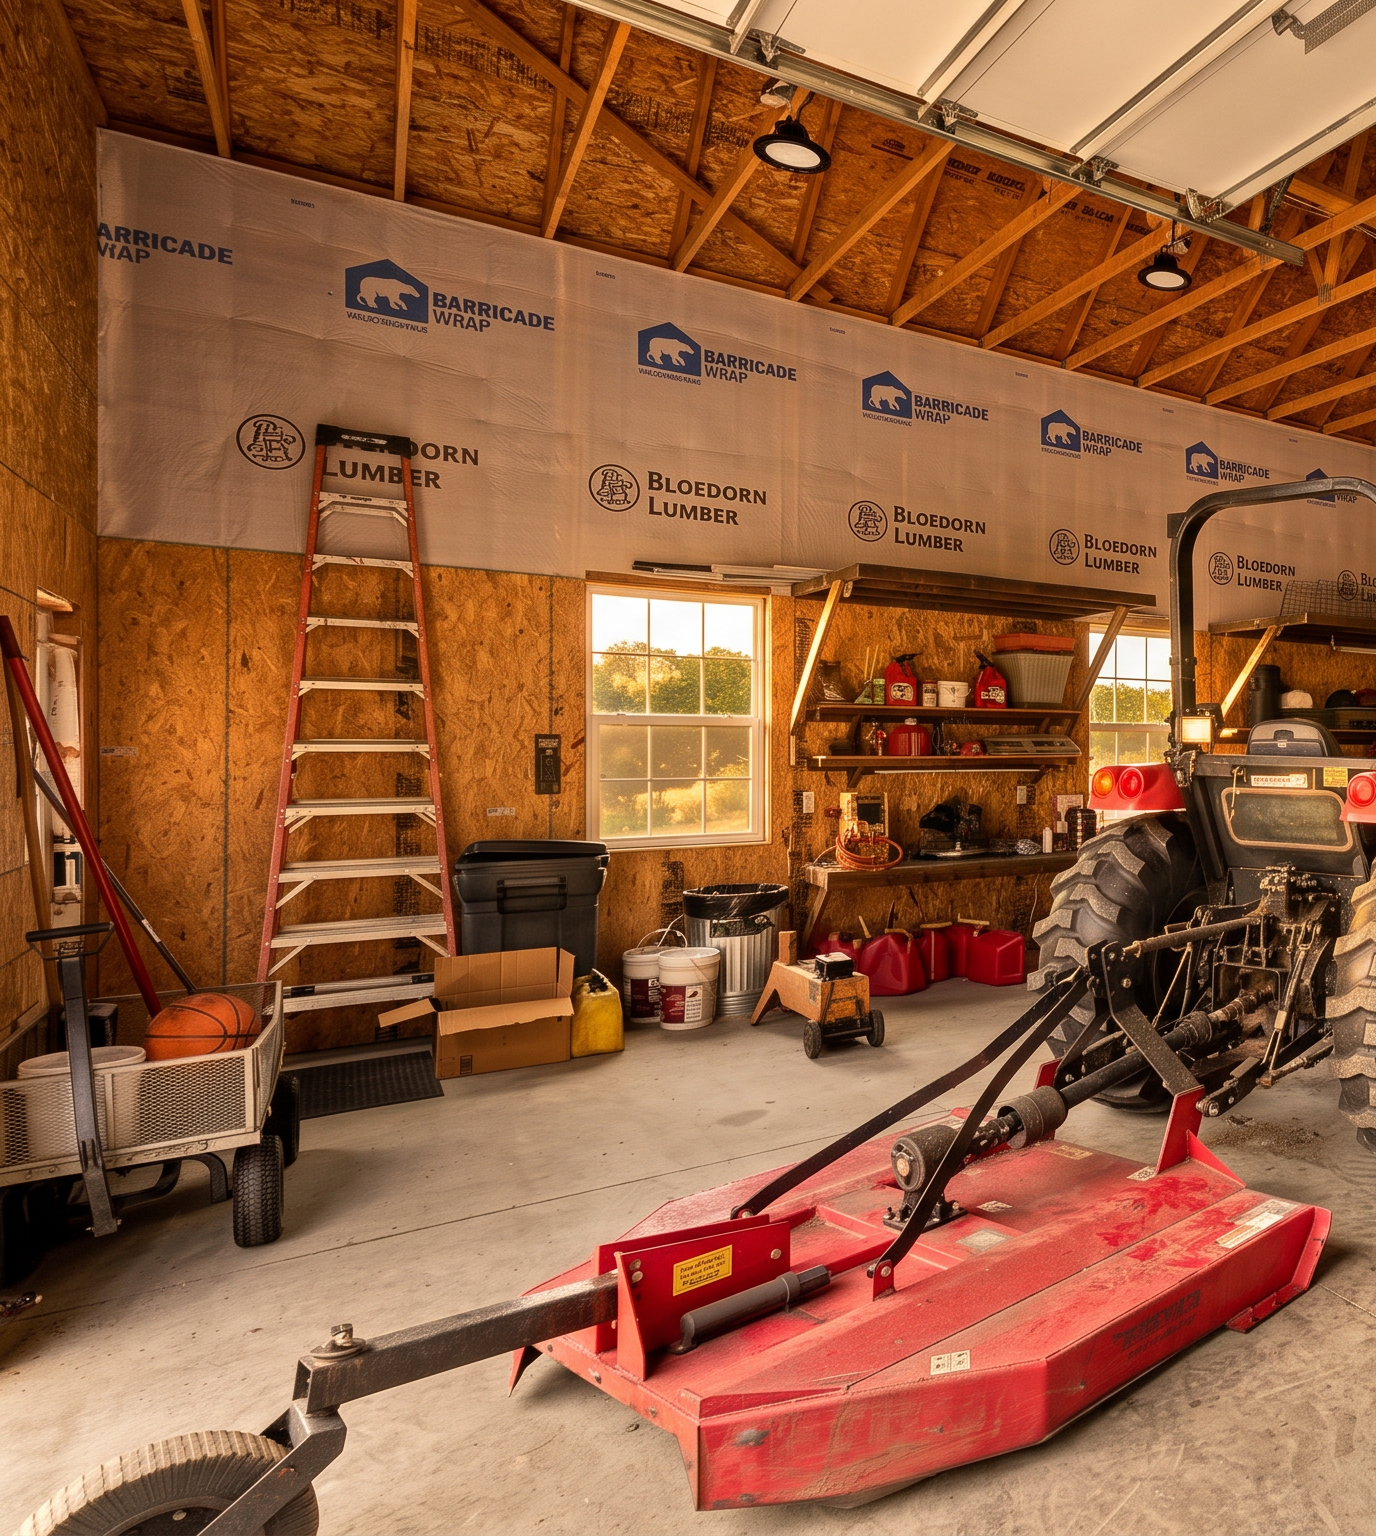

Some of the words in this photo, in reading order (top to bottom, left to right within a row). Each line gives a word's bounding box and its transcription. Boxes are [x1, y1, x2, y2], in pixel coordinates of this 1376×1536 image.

[432, 292, 555, 331] BARRICADE
[432, 309, 491, 332] WRAP
[704, 349, 797, 381] BARRICADE
[704, 365, 748, 383] WRAP
[914, 394, 989, 421] BARRICADE
[914, 408, 951, 424] WRAP
[1082, 430, 1143, 453] BARRICADE
[1082, 442, 1112, 457] WRAP
[325, 457, 442, 490] LUMBER
[1219, 459, 1270, 479] BARRICADE
[1219, 471, 1245, 483] WRAP
[647, 470, 767, 505] BLOEDORN
[648, 496, 739, 525] LUMBER
[893, 505, 986, 535] BLOEDORN
[894, 527, 964, 552] LUMBER
[1084, 533, 1157, 558] BLOEDORN
[1084, 552, 1140, 574] LUMBER
[1236, 554, 1296, 577] BLOEDORN
[1237, 572, 1283, 592] LUMBER
